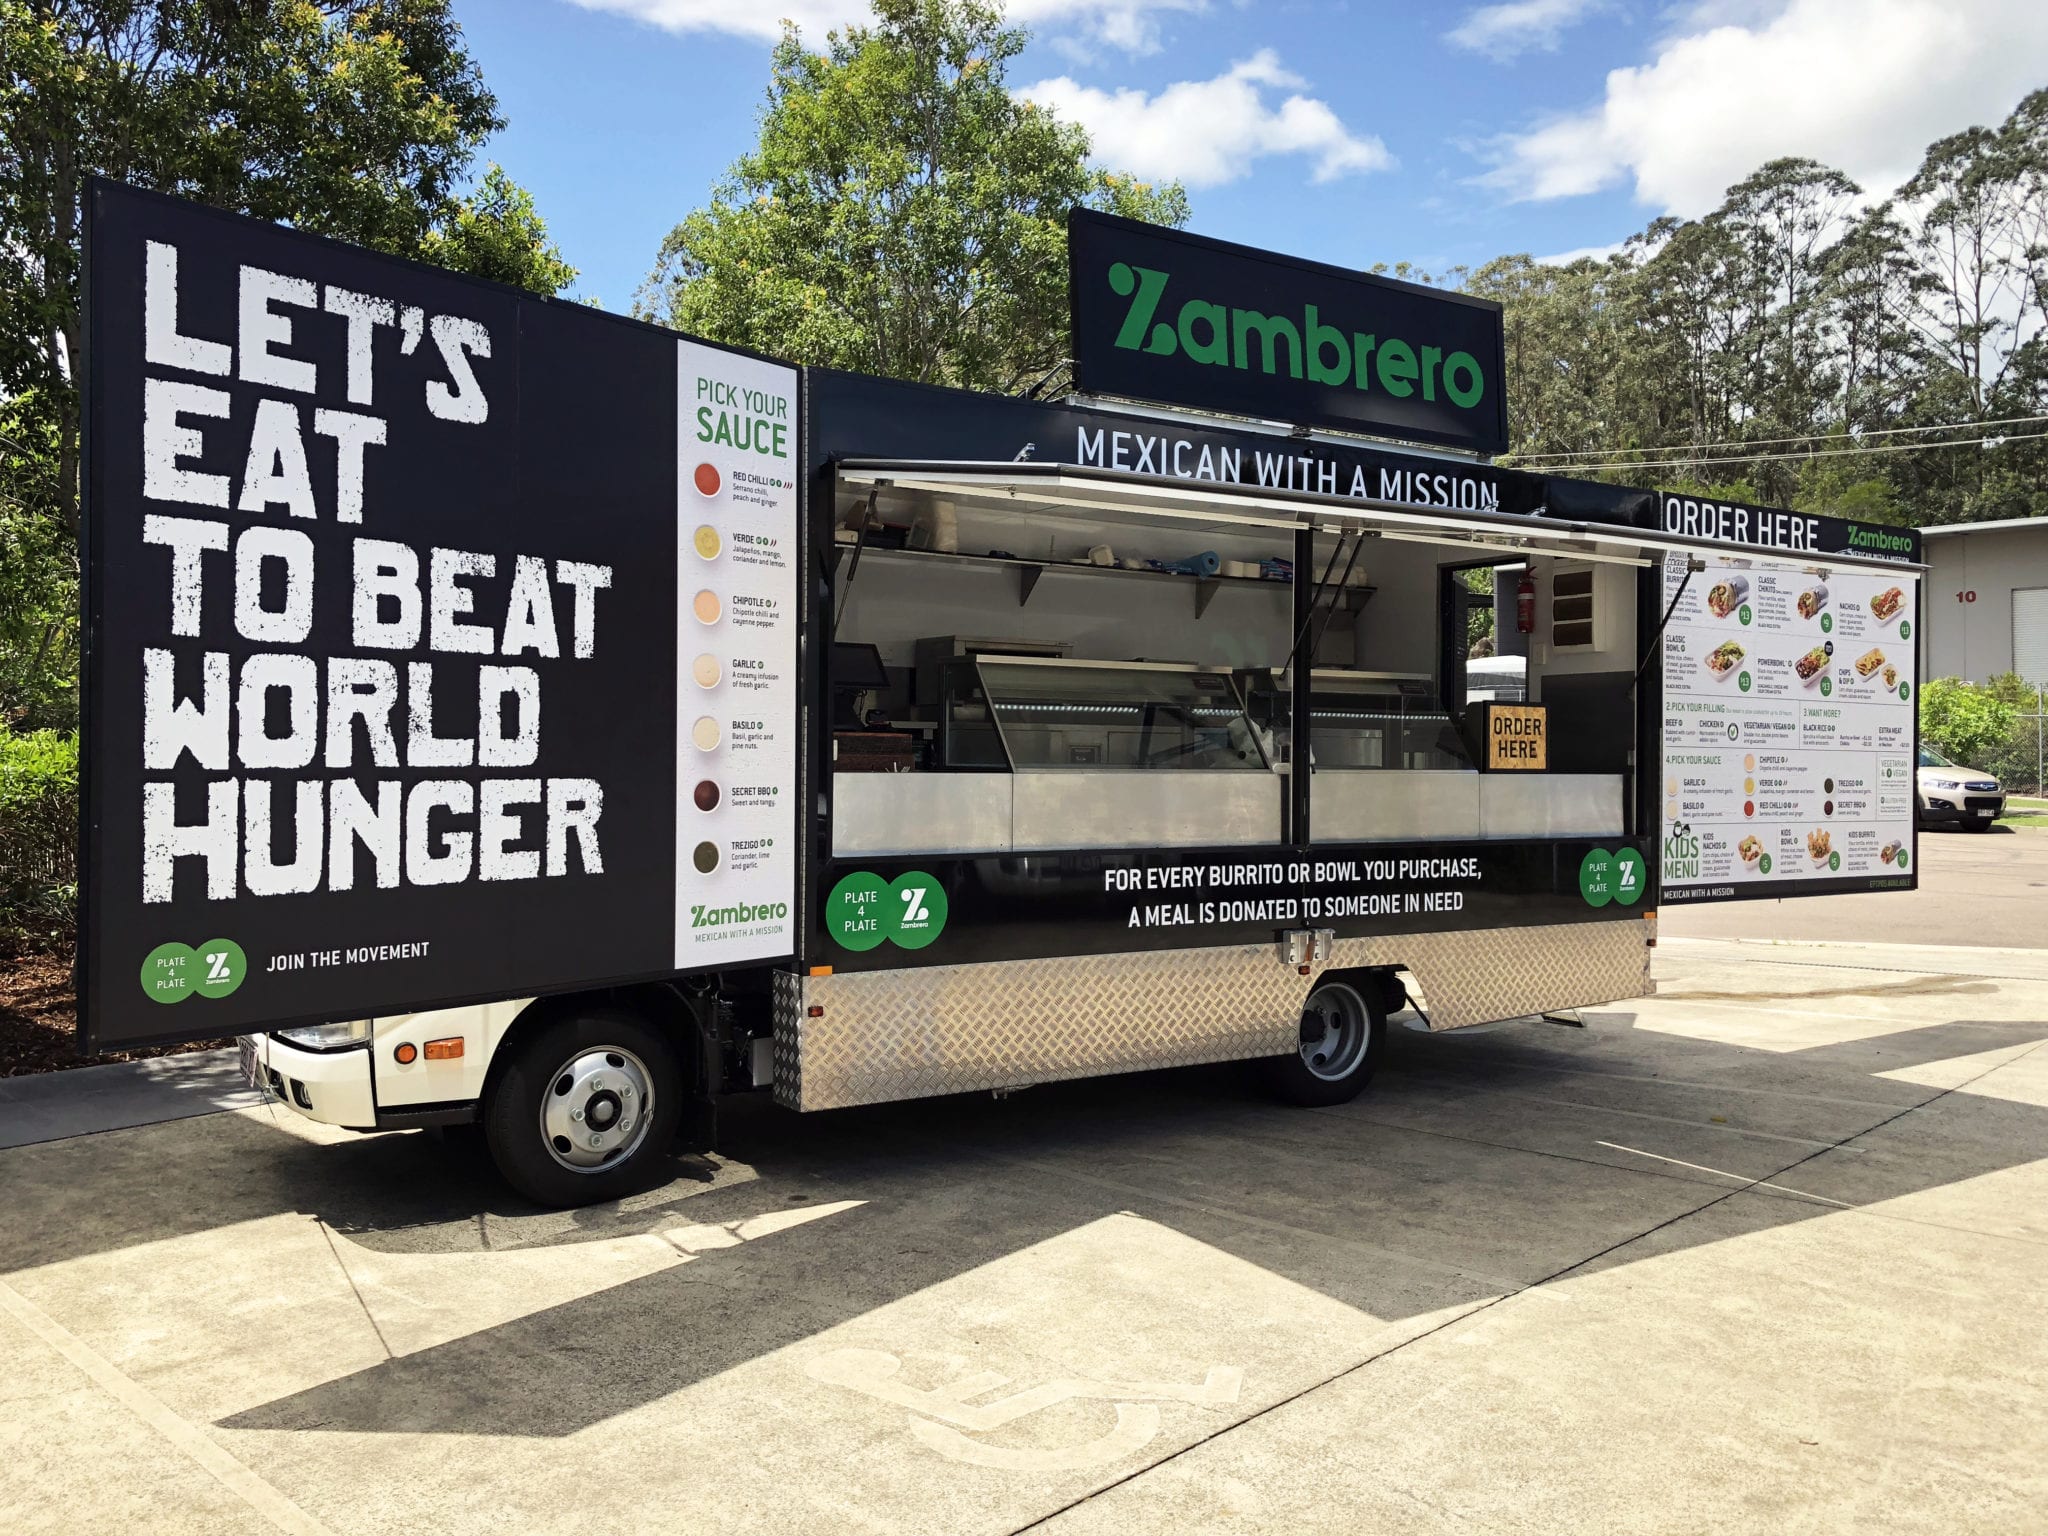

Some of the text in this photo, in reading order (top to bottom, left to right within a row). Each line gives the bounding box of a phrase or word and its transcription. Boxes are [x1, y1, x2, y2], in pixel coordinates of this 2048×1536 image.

[145, 239, 491, 424] LET'S
[1108, 262, 1484, 408] Zambrero
[697, 377, 787, 419] PICK YOUR
[696, 406, 787, 458] SAUCE
[143, 377, 387, 524] EAT
[1077, 425, 1498, 512] MEXICAN WITH A MISSION
[733, 471, 768, 485] RED CHILLI
[733, 483, 754, 493] Serrano
[733, 494, 749, 503] peach
[750, 495, 760, 504] and
[1666, 498, 1819, 551] ORDER HERE
[733, 532, 754, 544] VERDE
[1847, 525, 1913, 552] Zambrero
[733, 555, 758, 564] coriander
[759, 557, 768, 565] and
[1667, 566, 1686, 575] CLASSIC
[143, 513, 613, 658] TO BEAT
[1758, 576, 1776, 584] CLASSIC
[732, 596, 764, 607] CHIPOTLE
[1956, 590, 1977, 603] 10
[1839, 602, 1856, 611] NACHOS
[732, 607, 779, 619] Chipotle chilli and
[732, 618, 755, 627] cayenne
[1666, 634, 1686, 643] CLASSIC
[1666, 643, 1680, 652] BOWL
[732, 659, 756, 669] GARLIC
[736, 672, 757, 682] creamy
[757, 673, 779, 681] infusion
[143, 648, 541, 770] WORLD
[1686, 702, 1702, 712] YOUR
[1703, 703, 1725, 713] FILLING
[1823, 708, 1841, 718] MORE?
[732, 720, 755, 730] BASILO
[1494, 717, 1541, 736] ORDER
[1666, 718, 1678, 726] BEEF
[1699, 720, 1719, 728] CHICKEN
[1773, 722, 1787, 730] VEGAN
[1817, 724, 1827, 732] RICE
[747, 733, 762, 742] garlic
[732, 742, 743, 751] pine
[1498, 740, 1537, 758] HERE
[1686, 755, 1702, 765] YOUR
[1703, 755, 1721, 765] SAUCE
[732, 787, 771, 796] SECRET BBQ
[732, 799, 748, 807] Sweet
[1682, 802, 1699, 810] BASILO
[143, 776, 604, 904] HUNGER
[1703, 833, 1714, 841] KIDS
[1848, 831, 1858, 839] KIDS
[732, 840, 759, 850] TREZIGO
[1664, 836, 1699, 859] KIDS
[1703, 842, 1722, 850] NACHOS
[1588, 863, 1607, 872] PLATE
[1664, 860, 1699, 879] MENU
[1105, 858, 1482, 891] FOR EVERY BURRITO OR BOWL YOU PURCHASE,
[1596, 873, 1600, 881] 4
[1588, 883, 1607, 893] PLATE
[844, 891, 878, 904] PLATE
[1663, 889, 1690, 900] MEXICAN
[1691, 888, 1706, 897] WITH
[1711, 888, 1735, 896] MISSION
[690, 902, 788, 928] Zambrero
[857, 905, 865, 917] 4
[1128, 892, 1463, 928] A MEAL IS DONATED TO SOMEONE IN NEED
[844, 919, 877, 932] PLATE
[695, 925, 783, 942] MEXICAN WITH A MISSION
[157, 956, 186, 968] PLATE
[266, 942, 430, 972] JOIN THE MOVEMENT
[168, 968, 175, 977] 4
[157, 978, 185, 989] PLATE
